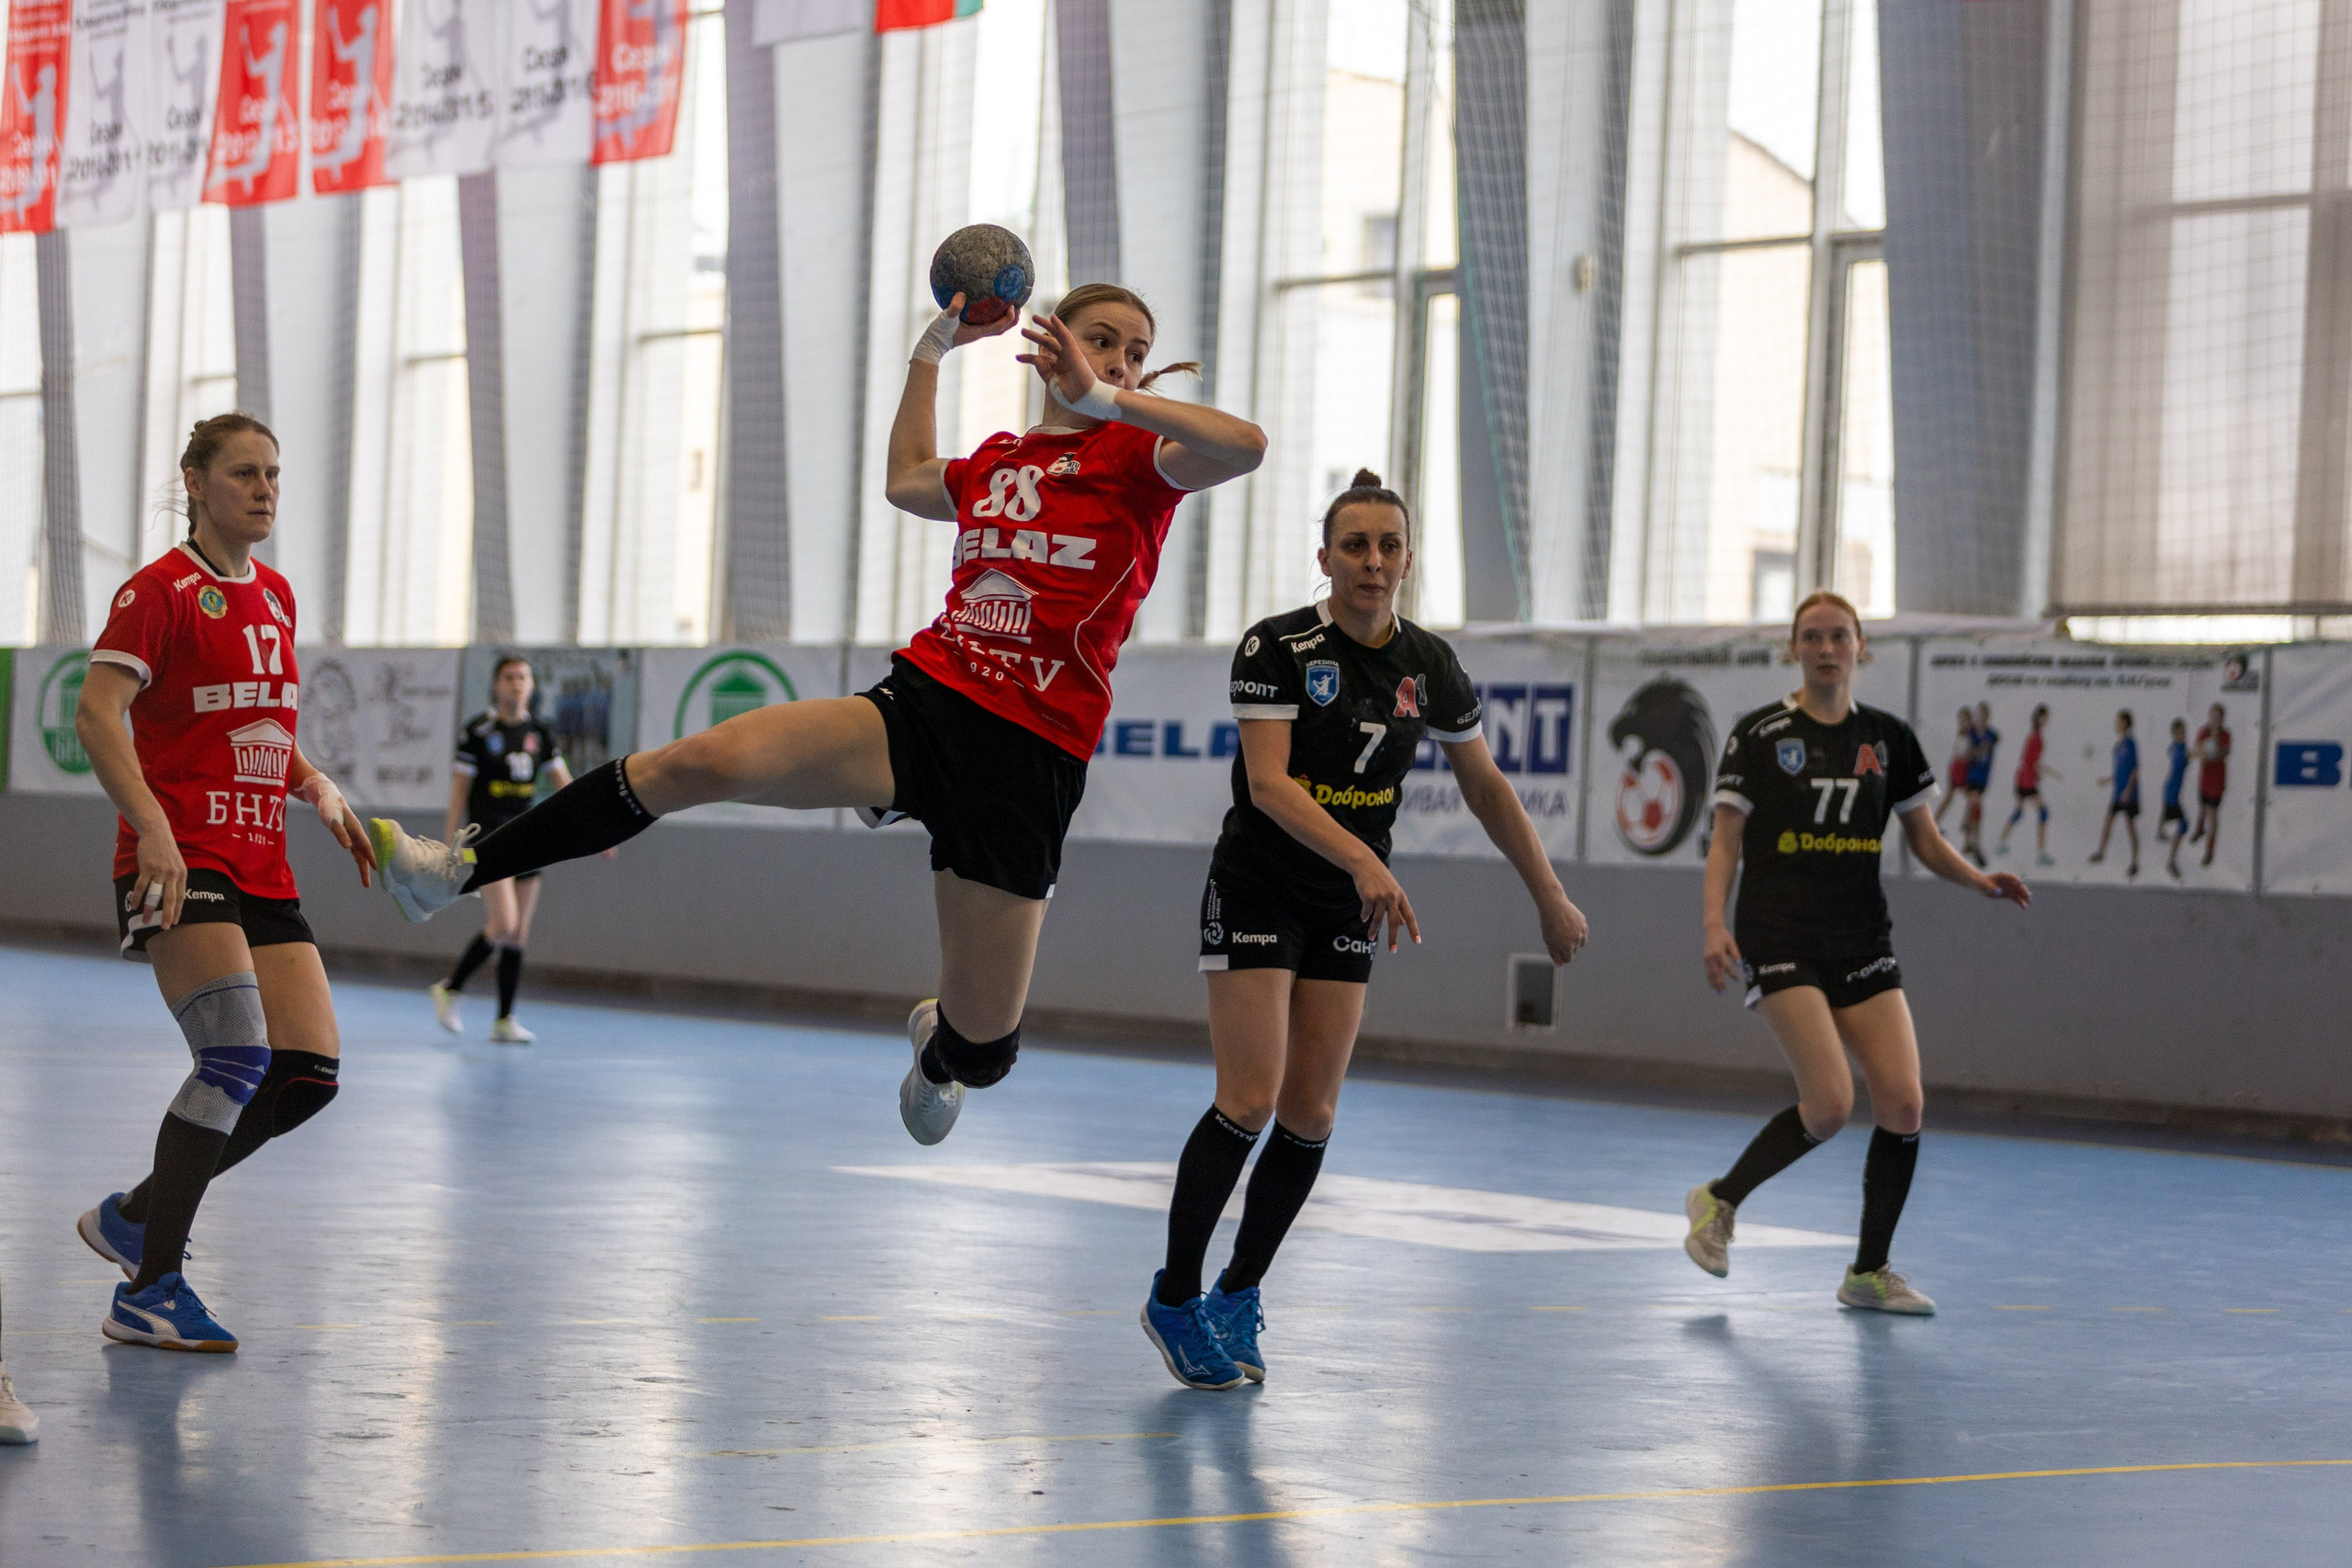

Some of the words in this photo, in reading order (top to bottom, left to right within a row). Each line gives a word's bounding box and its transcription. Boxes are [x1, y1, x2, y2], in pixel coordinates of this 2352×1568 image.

[972, 465, 1046, 522] 88
[174, 571, 202, 593] Kempa
[243, 625, 283, 675] 17
[1094, 719, 1240, 758] ELA
[1353, 721, 1386, 773] 7
[1316, 784, 1394, 809] Доброно
[1811, 778, 1860, 824] 77
[1232, 931, 1277, 945] Kempa
